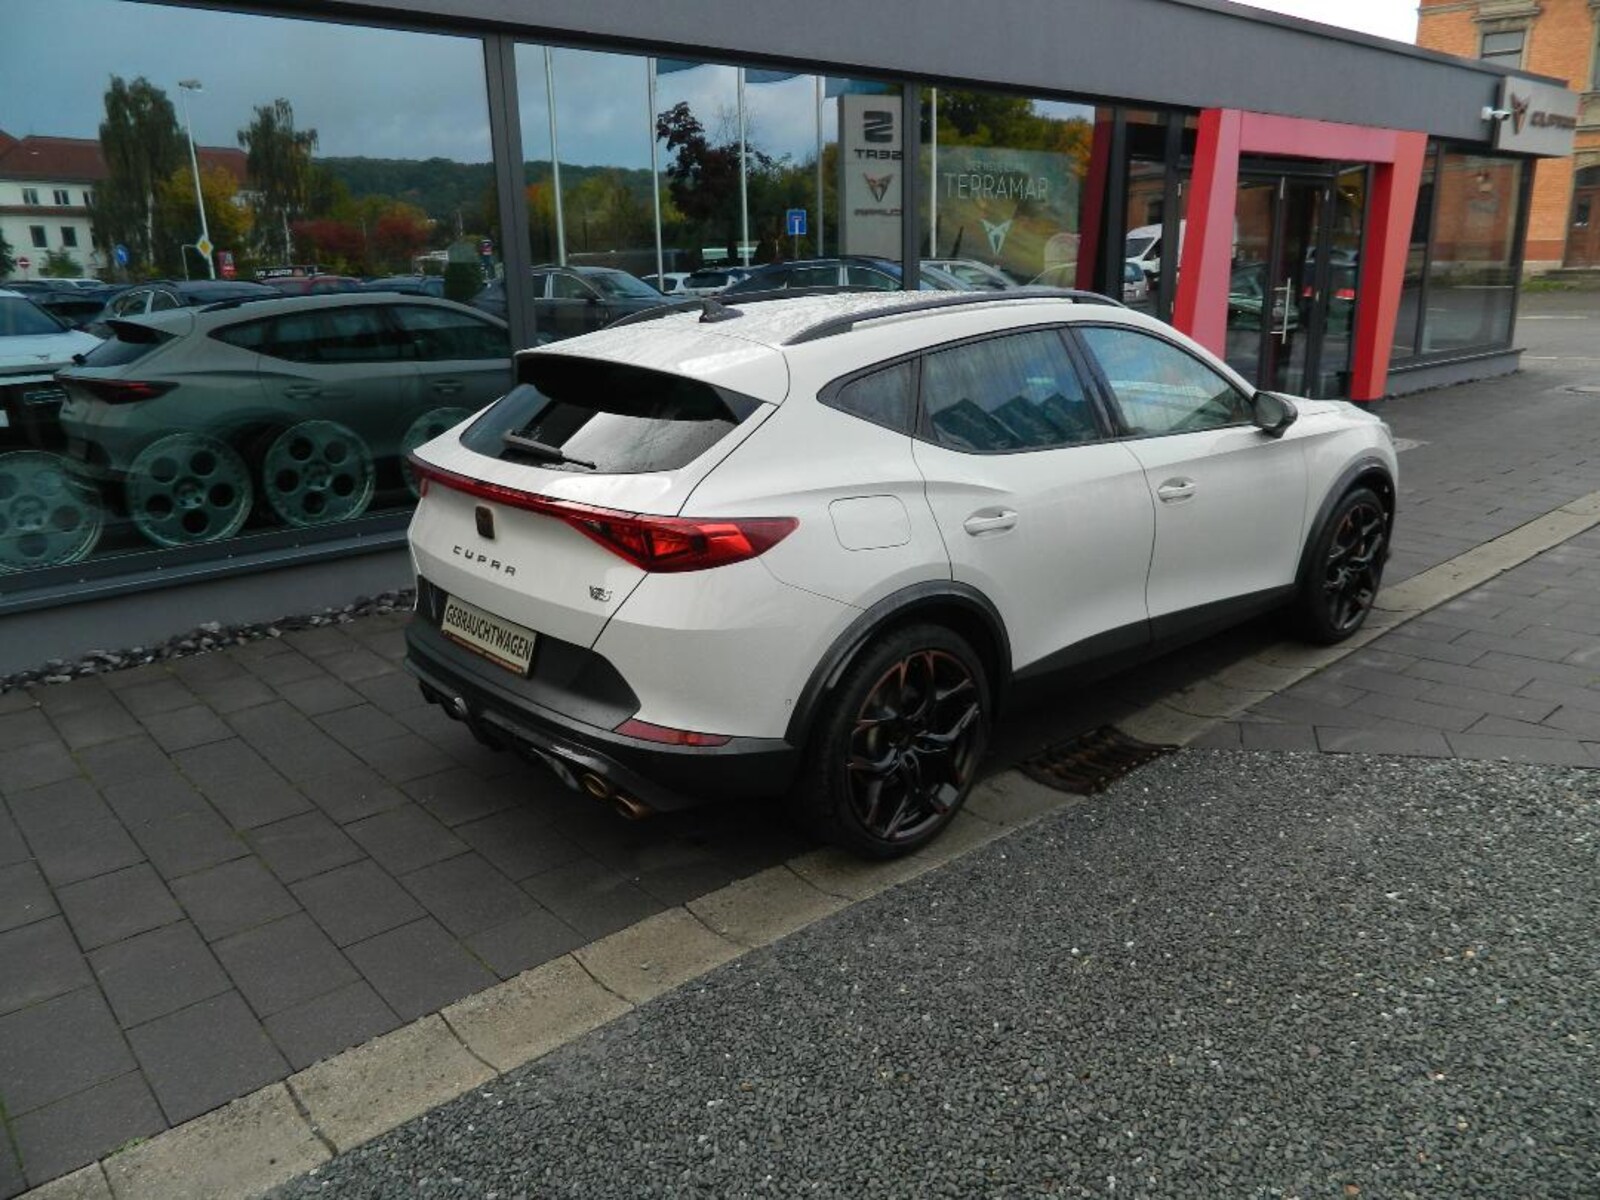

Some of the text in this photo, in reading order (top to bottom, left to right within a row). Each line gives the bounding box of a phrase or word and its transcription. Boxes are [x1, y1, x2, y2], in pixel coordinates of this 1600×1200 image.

[1530, 110, 1577, 130] CUP
[943, 172, 1049, 200] TERRAMAR
[453, 545, 517, 577] CUPRA
[445, 603, 534, 662] GEBRAUCHTWAGEN
